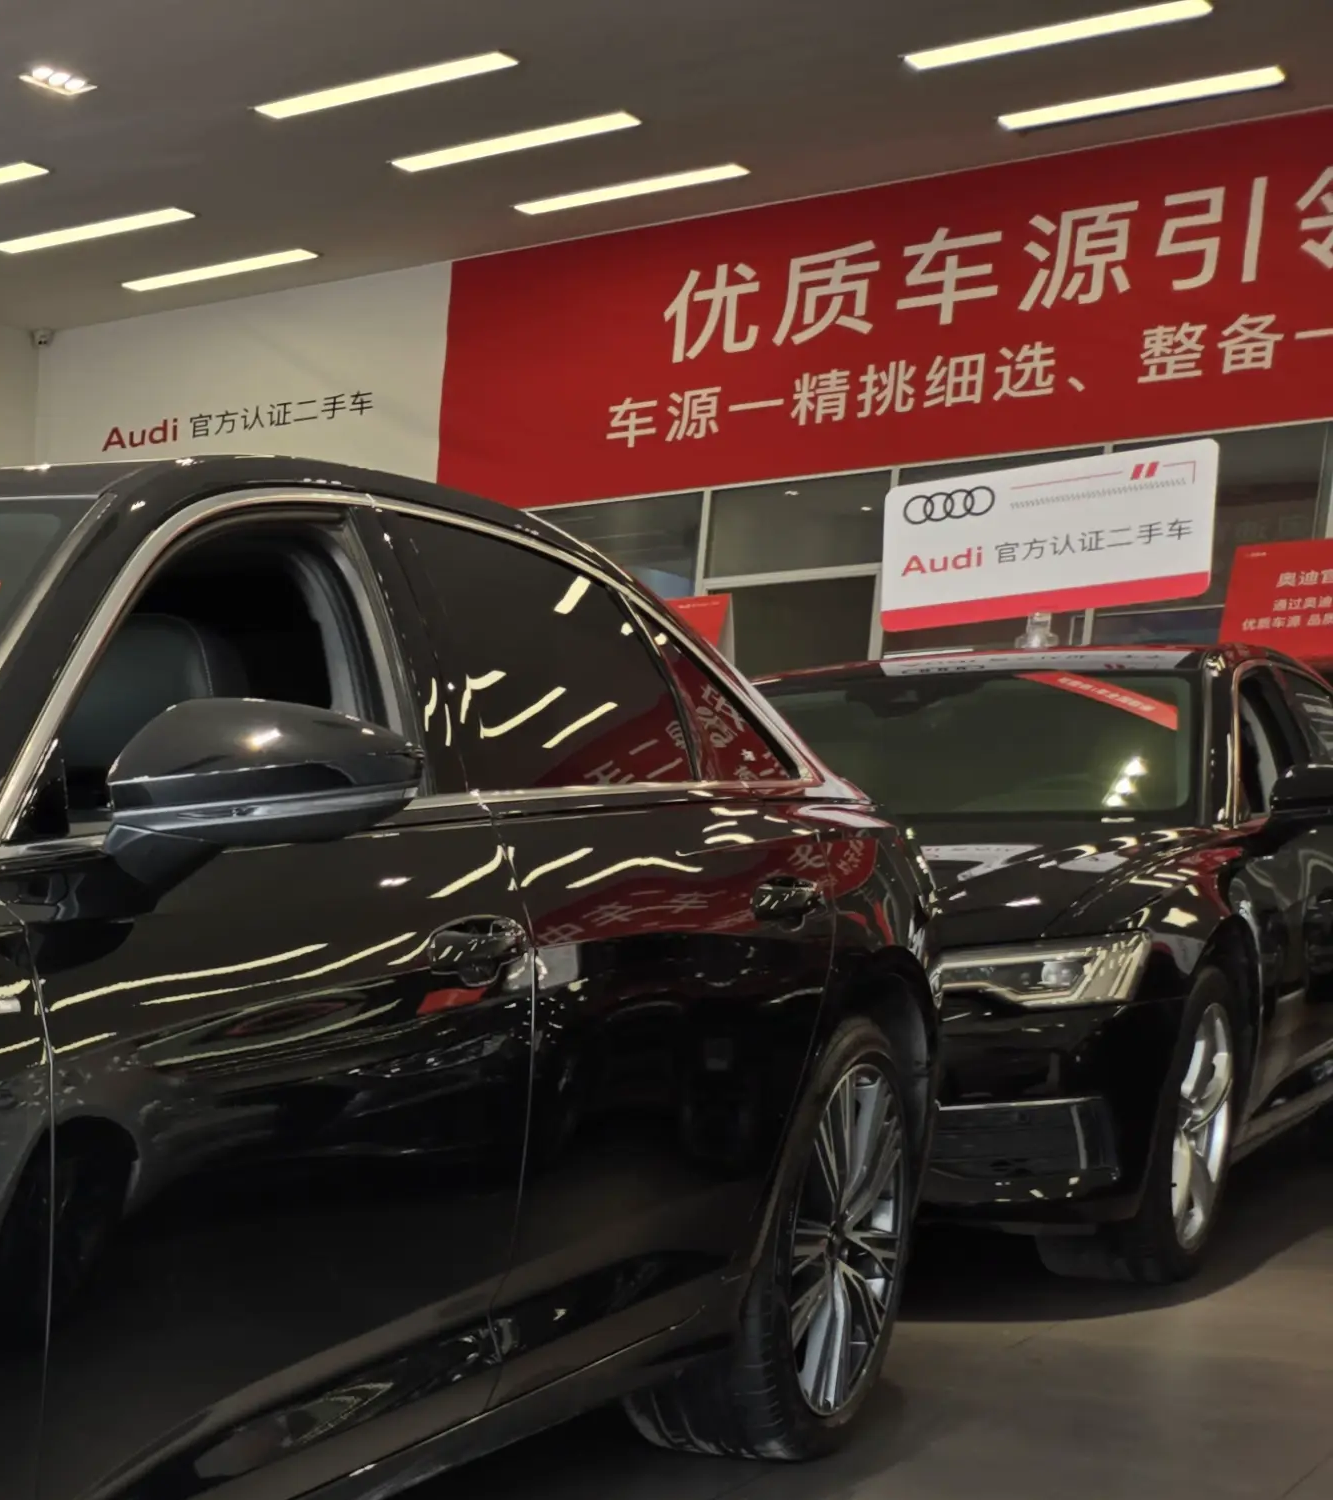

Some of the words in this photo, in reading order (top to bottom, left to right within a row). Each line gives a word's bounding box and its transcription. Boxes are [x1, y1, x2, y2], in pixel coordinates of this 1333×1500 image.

[101, 417, 178, 452] Audi
[189, 390, 374, 439] 官方认证二手车
[900, 546, 983, 577] Audi
[993, 518, 1194, 565] 官方认证二手车
